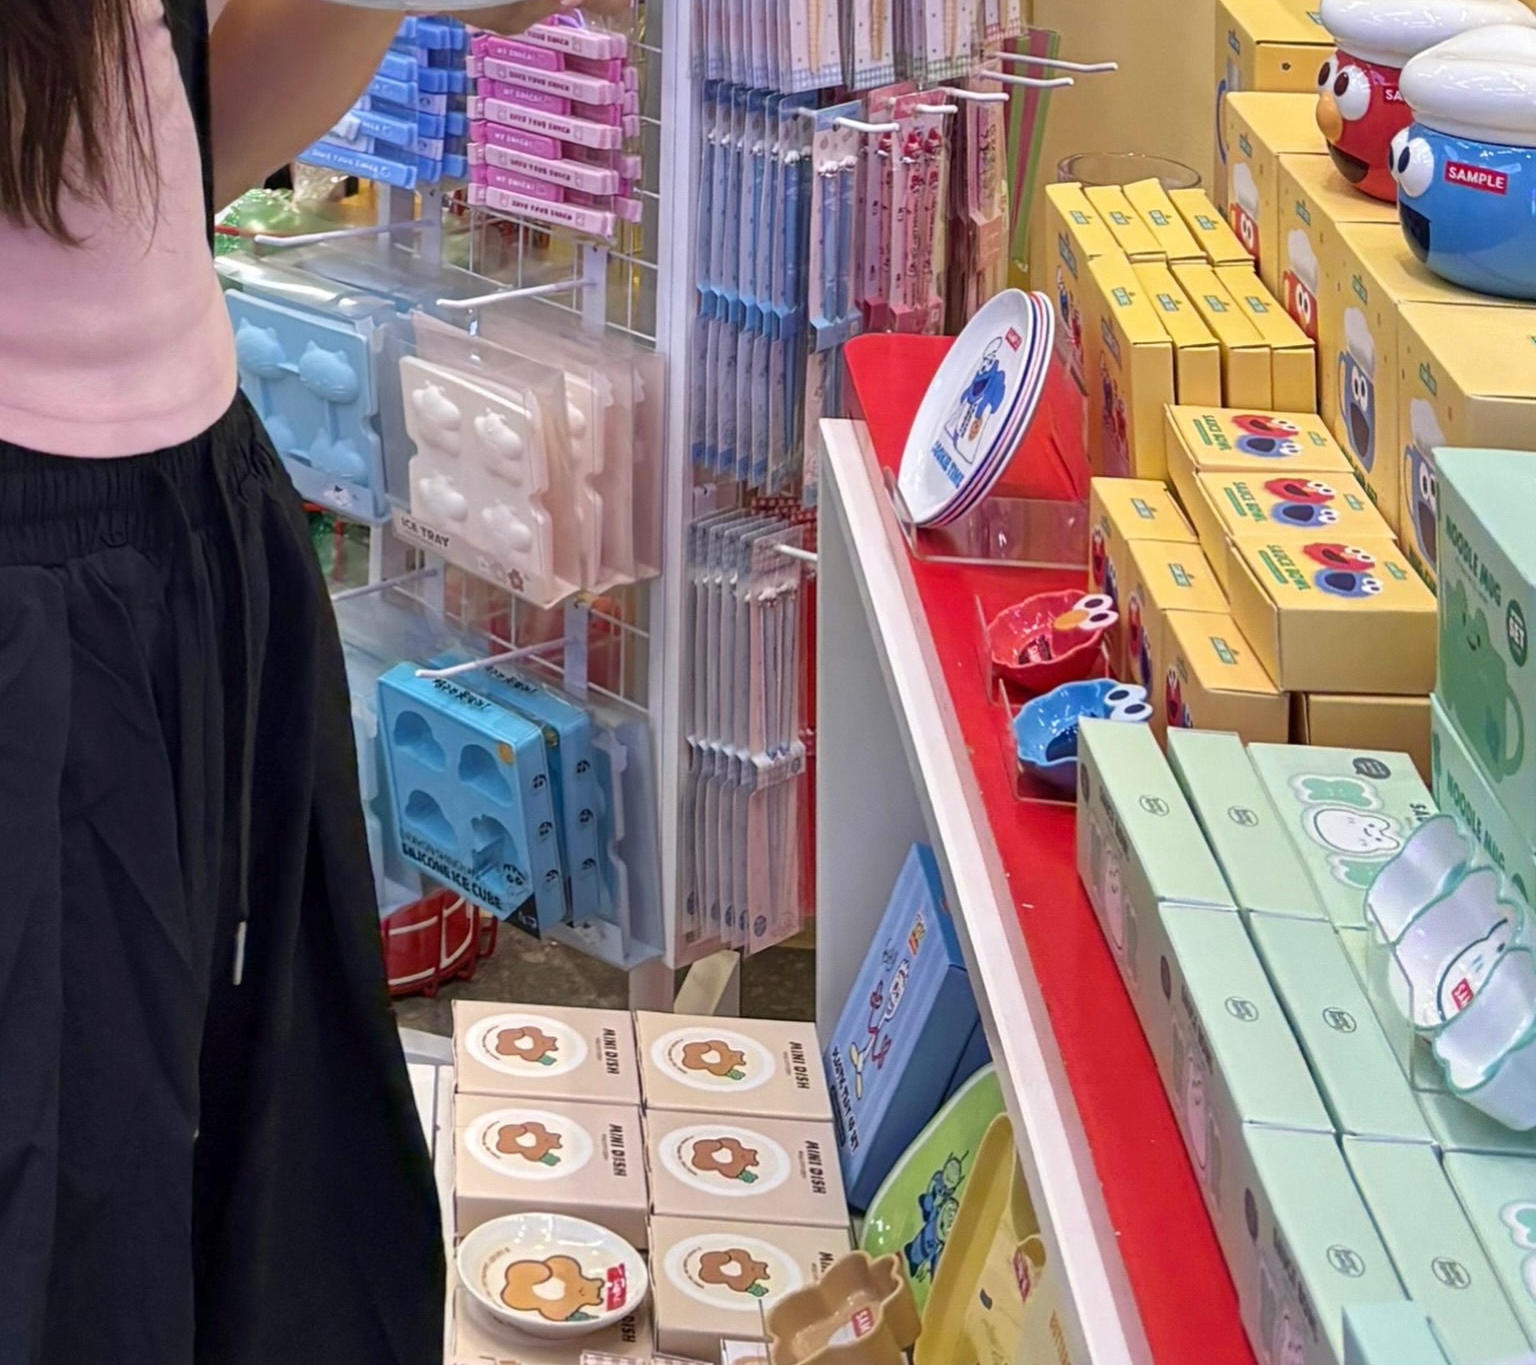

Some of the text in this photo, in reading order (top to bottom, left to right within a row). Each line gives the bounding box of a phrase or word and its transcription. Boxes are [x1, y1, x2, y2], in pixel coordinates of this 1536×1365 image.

[1448, 166, 1505, 189] SAMPLE
[420, 526, 451, 548] TRAY
[1445, 513, 1479, 578] NOODLE
[471, 879, 504, 911] CUBE
[602, 1027, 620, 1075] MINI DISH
[789, 1041, 810, 1090] MINI DISH
[608, 1123, 627, 1177] MINI DISH
[805, 1140, 827, 1195] MINI DISH
